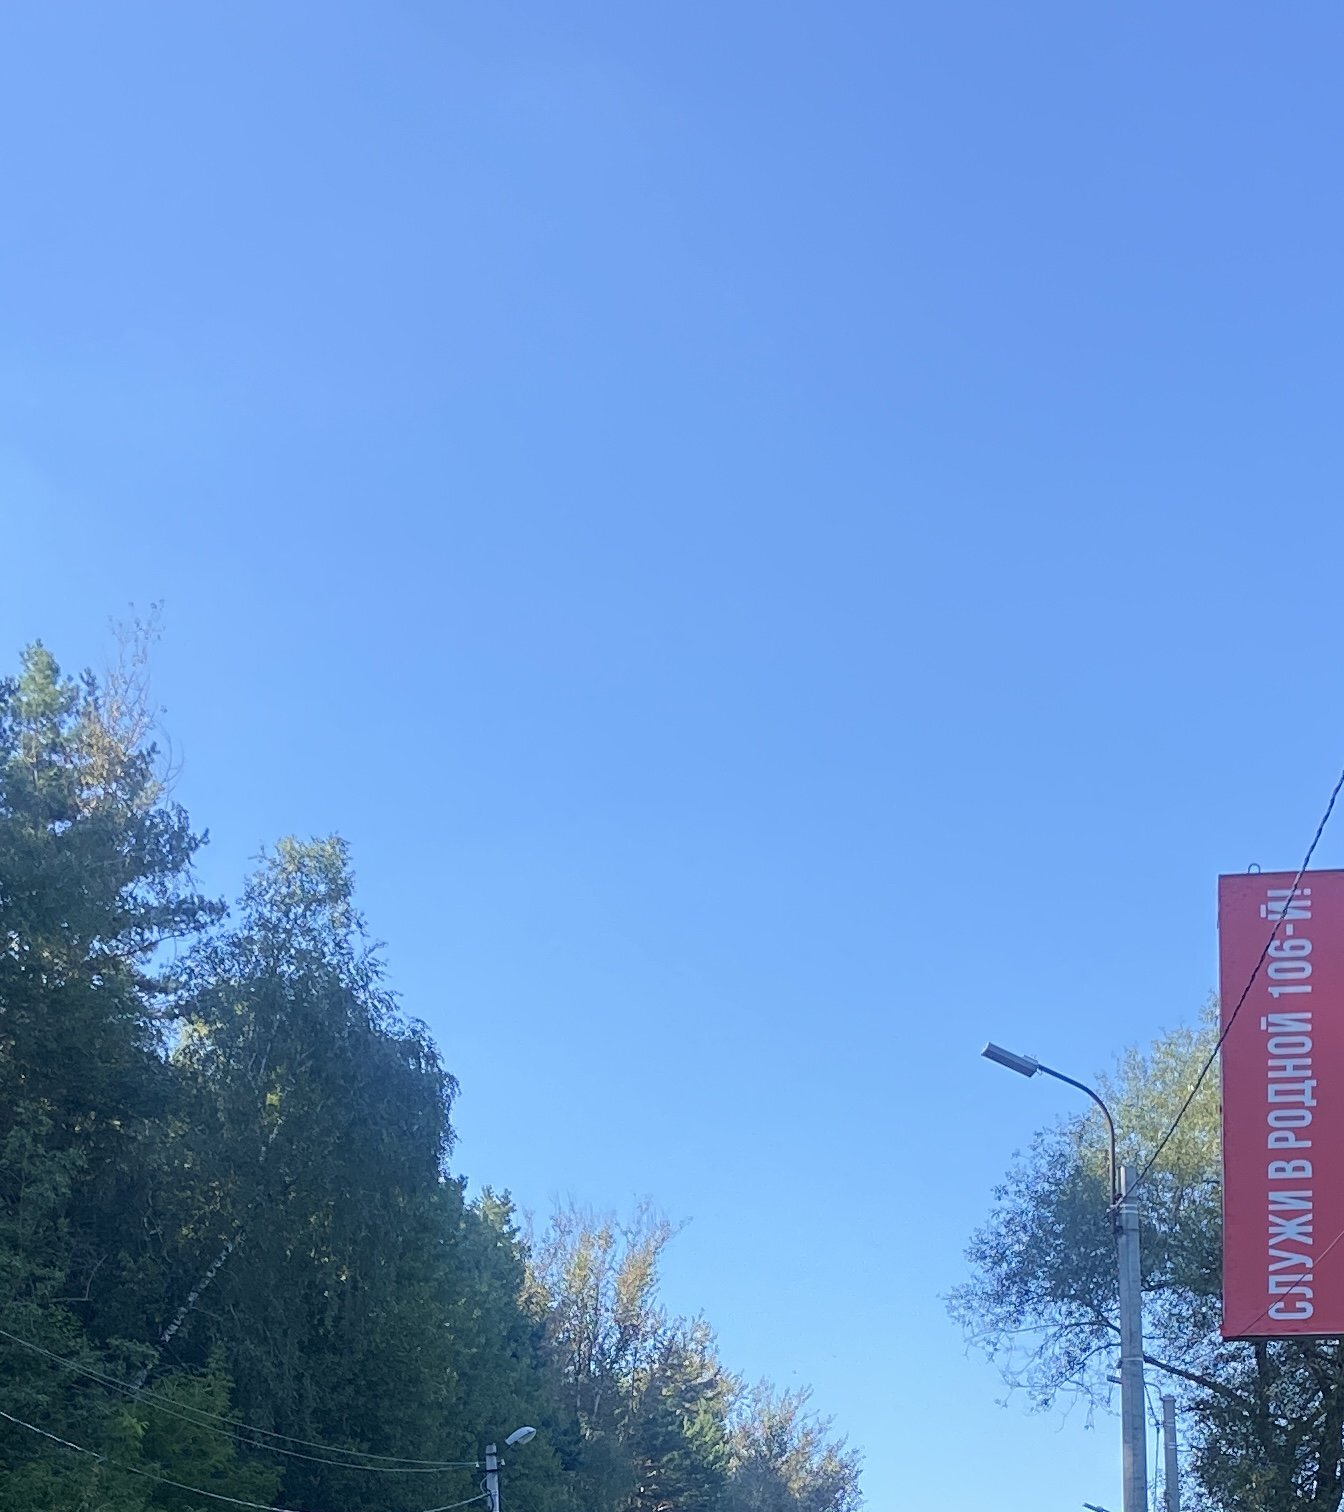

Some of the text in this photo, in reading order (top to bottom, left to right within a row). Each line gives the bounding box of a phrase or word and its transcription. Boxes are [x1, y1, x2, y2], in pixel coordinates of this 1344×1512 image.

[1259, 888, 1317, 1320] СЛУЖИ В РОДНОЙ 106-Й!
